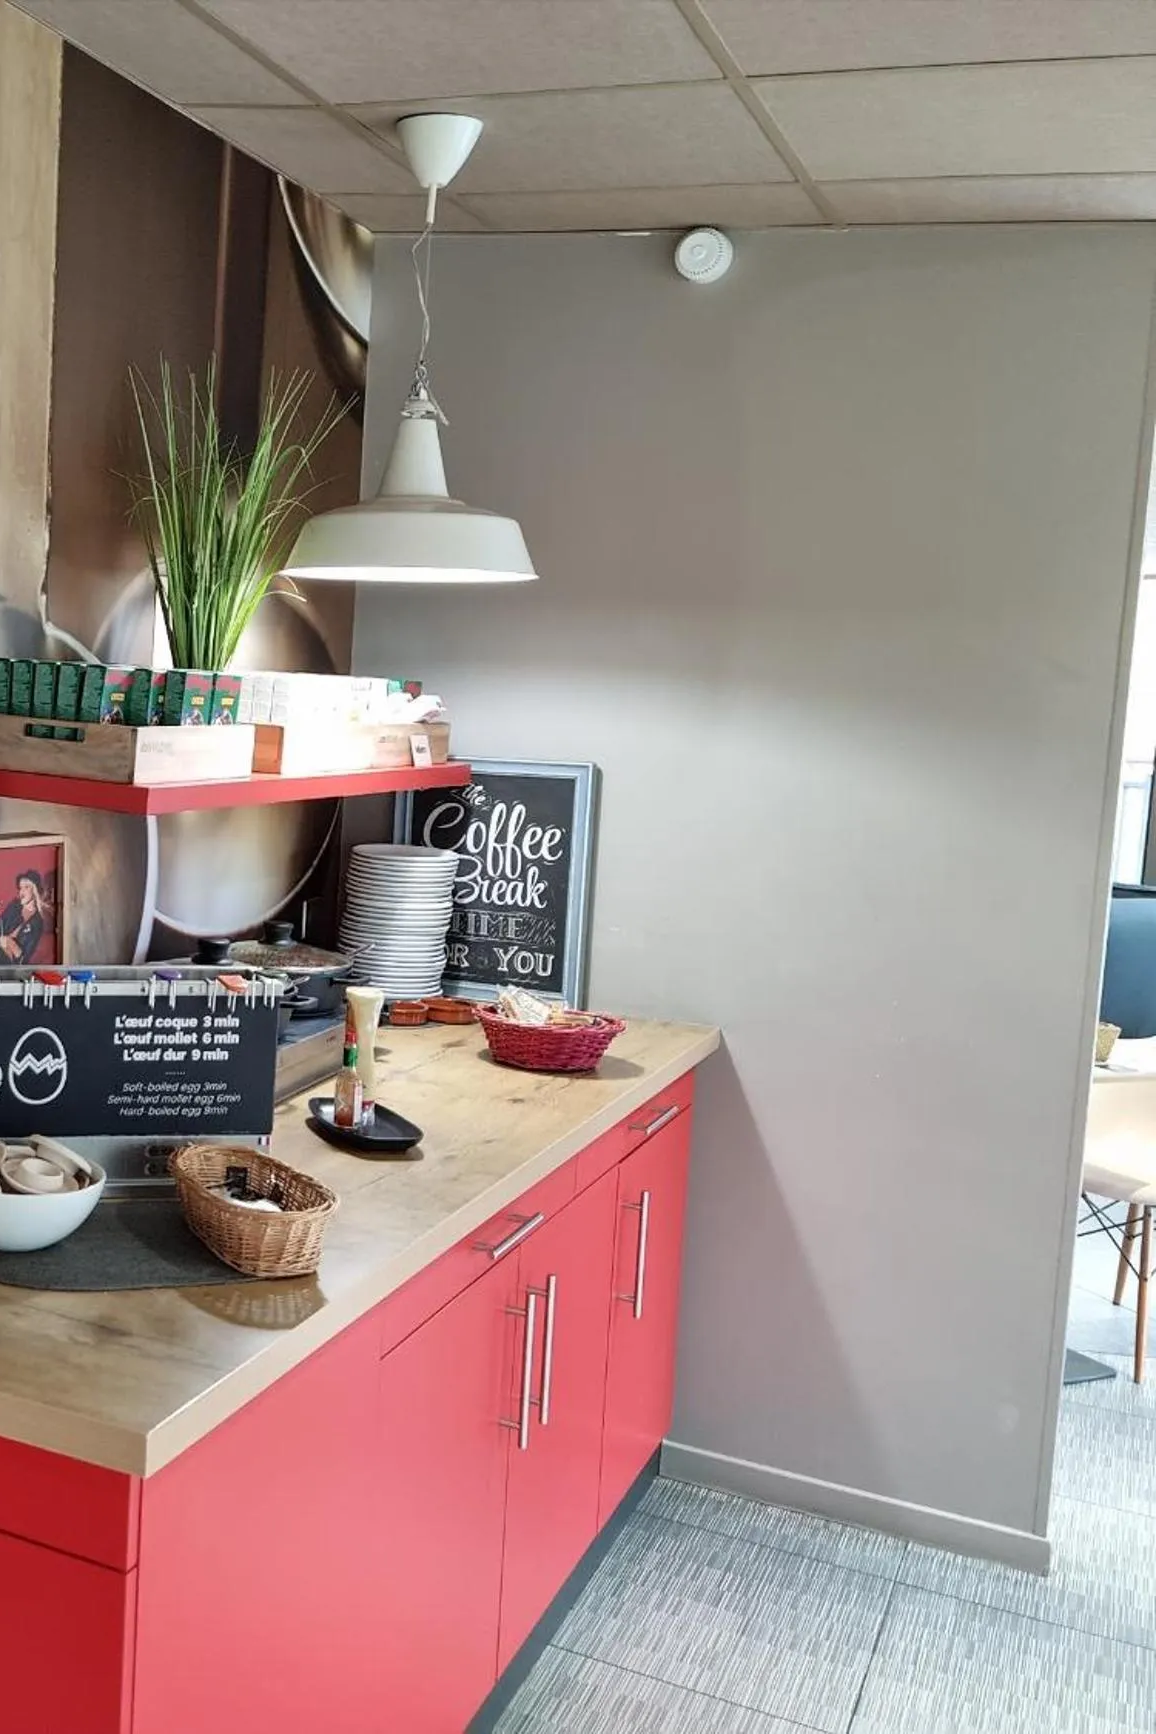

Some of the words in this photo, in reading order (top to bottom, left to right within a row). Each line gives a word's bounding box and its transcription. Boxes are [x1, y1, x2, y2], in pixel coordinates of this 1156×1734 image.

[423, 802, 563, 878] Coffee
[454, 853, 548, 909] Break
[450, 912, 524, 938] TIME
[492, 946, 555, 976] YOU
[155, 1017, 198, 1031] coque
[203, 1016, 212, 1028] 3
[214, 1014, 240, 1028] min
[154, 1032, 198, 1044] mollet
[202, 1032, 212, 1044] 6
[214, 1031, 240, 1044] min
[163, 1048, 187, 1061] dur
[192, 1049, 201, 1061] 9
[203, 1047, 229, 1061] min
[180, 1083, 201, 1094] egg
[194, 1095, 215, 1106] egg
[181, 1107, 202, 1117] egg
